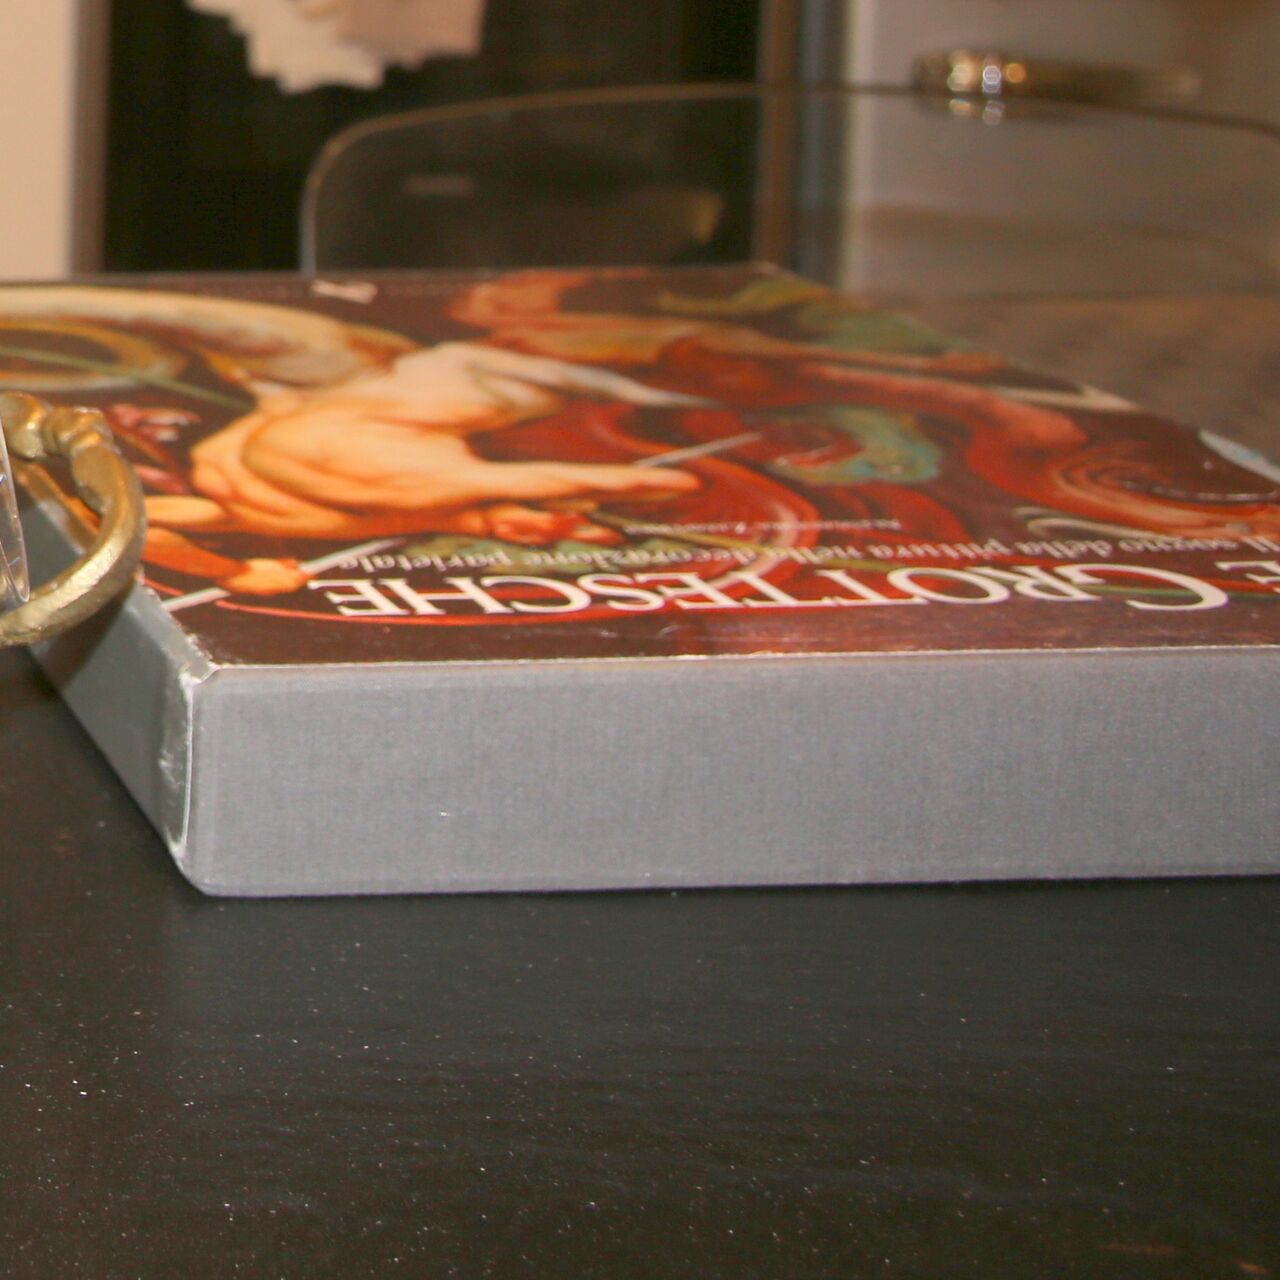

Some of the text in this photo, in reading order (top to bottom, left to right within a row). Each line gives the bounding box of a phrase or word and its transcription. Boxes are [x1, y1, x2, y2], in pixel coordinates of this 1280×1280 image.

[766, 544, 863, 564] nella
[870, 538, 1012, 560] pittura
[1016, 538, 1114, 559] della
[1119, 536, 1238, 553] sogno
[341, 549, 513, 573] parietale
[523, 547, 758, 569] decorazione
[307, 562, 1229, 616] GROTTESCHE
